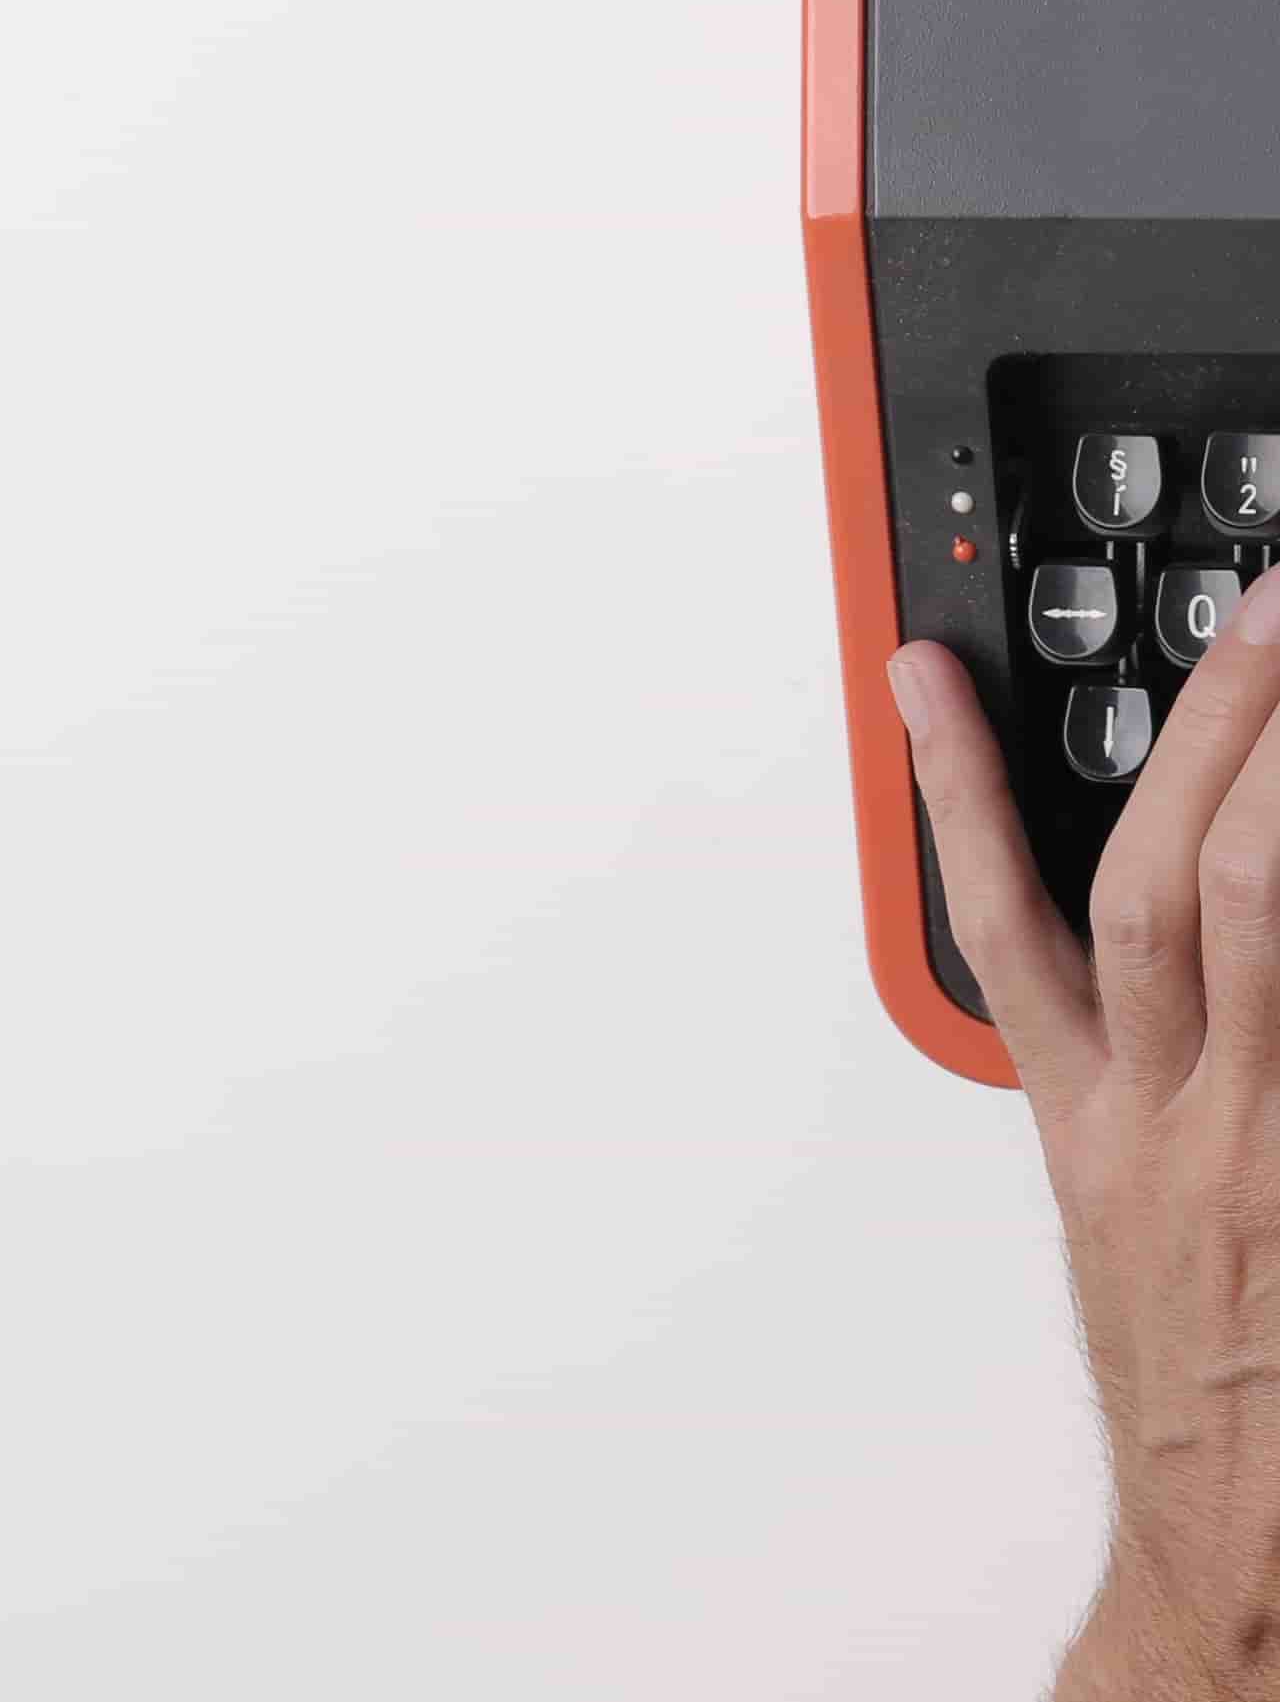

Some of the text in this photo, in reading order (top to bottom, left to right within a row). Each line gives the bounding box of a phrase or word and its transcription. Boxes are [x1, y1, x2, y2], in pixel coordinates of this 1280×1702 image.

[1108, 449, 1128, 481] §
[1113, 484, 1127, 517] í
[1238, 483, 1257, 515] 2
[1186, 594, 1218, 639] Q
